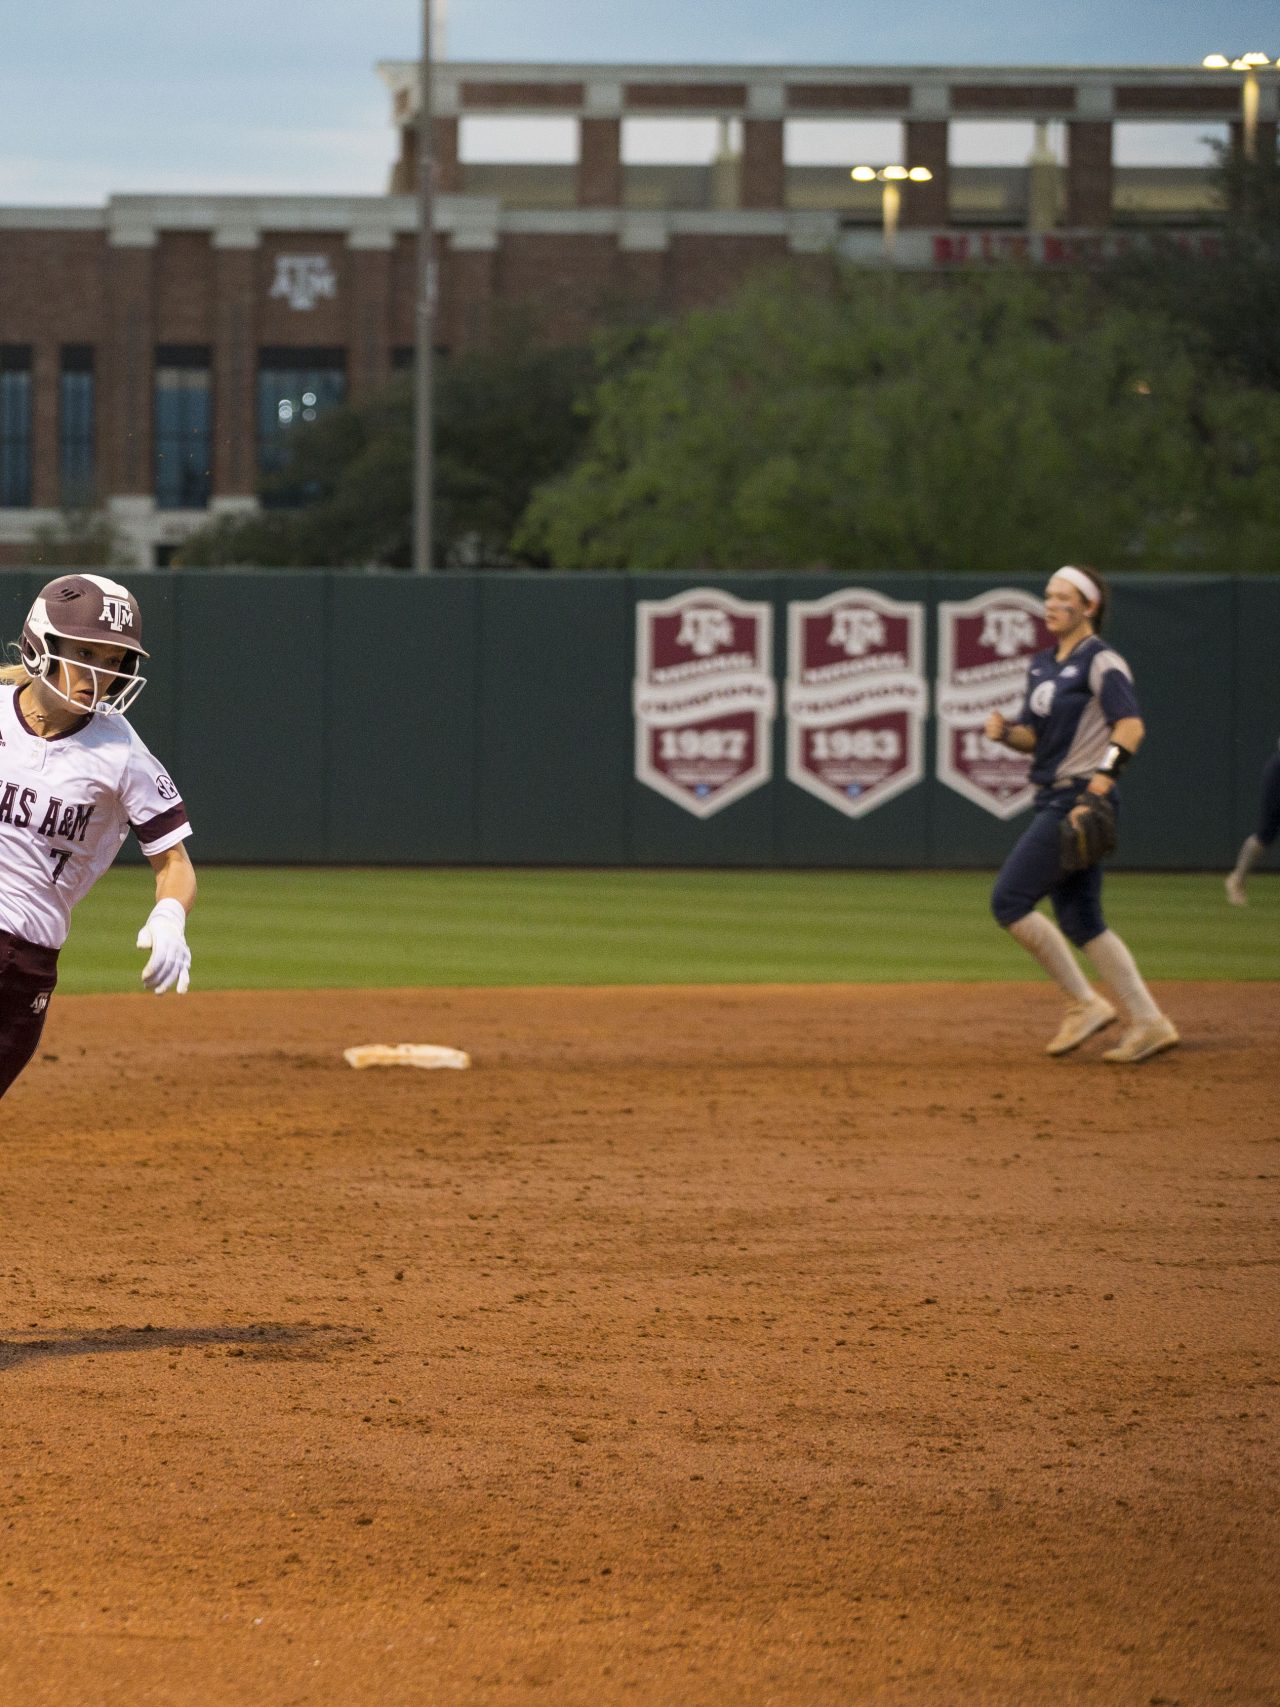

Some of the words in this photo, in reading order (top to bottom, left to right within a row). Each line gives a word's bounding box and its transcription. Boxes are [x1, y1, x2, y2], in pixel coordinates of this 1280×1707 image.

[659, 729, 747, 760] 1987
[809, 729, 898, 760] 1983
[37, 796, 97, 842] A&M
[50, 848, 72, 884] 7
